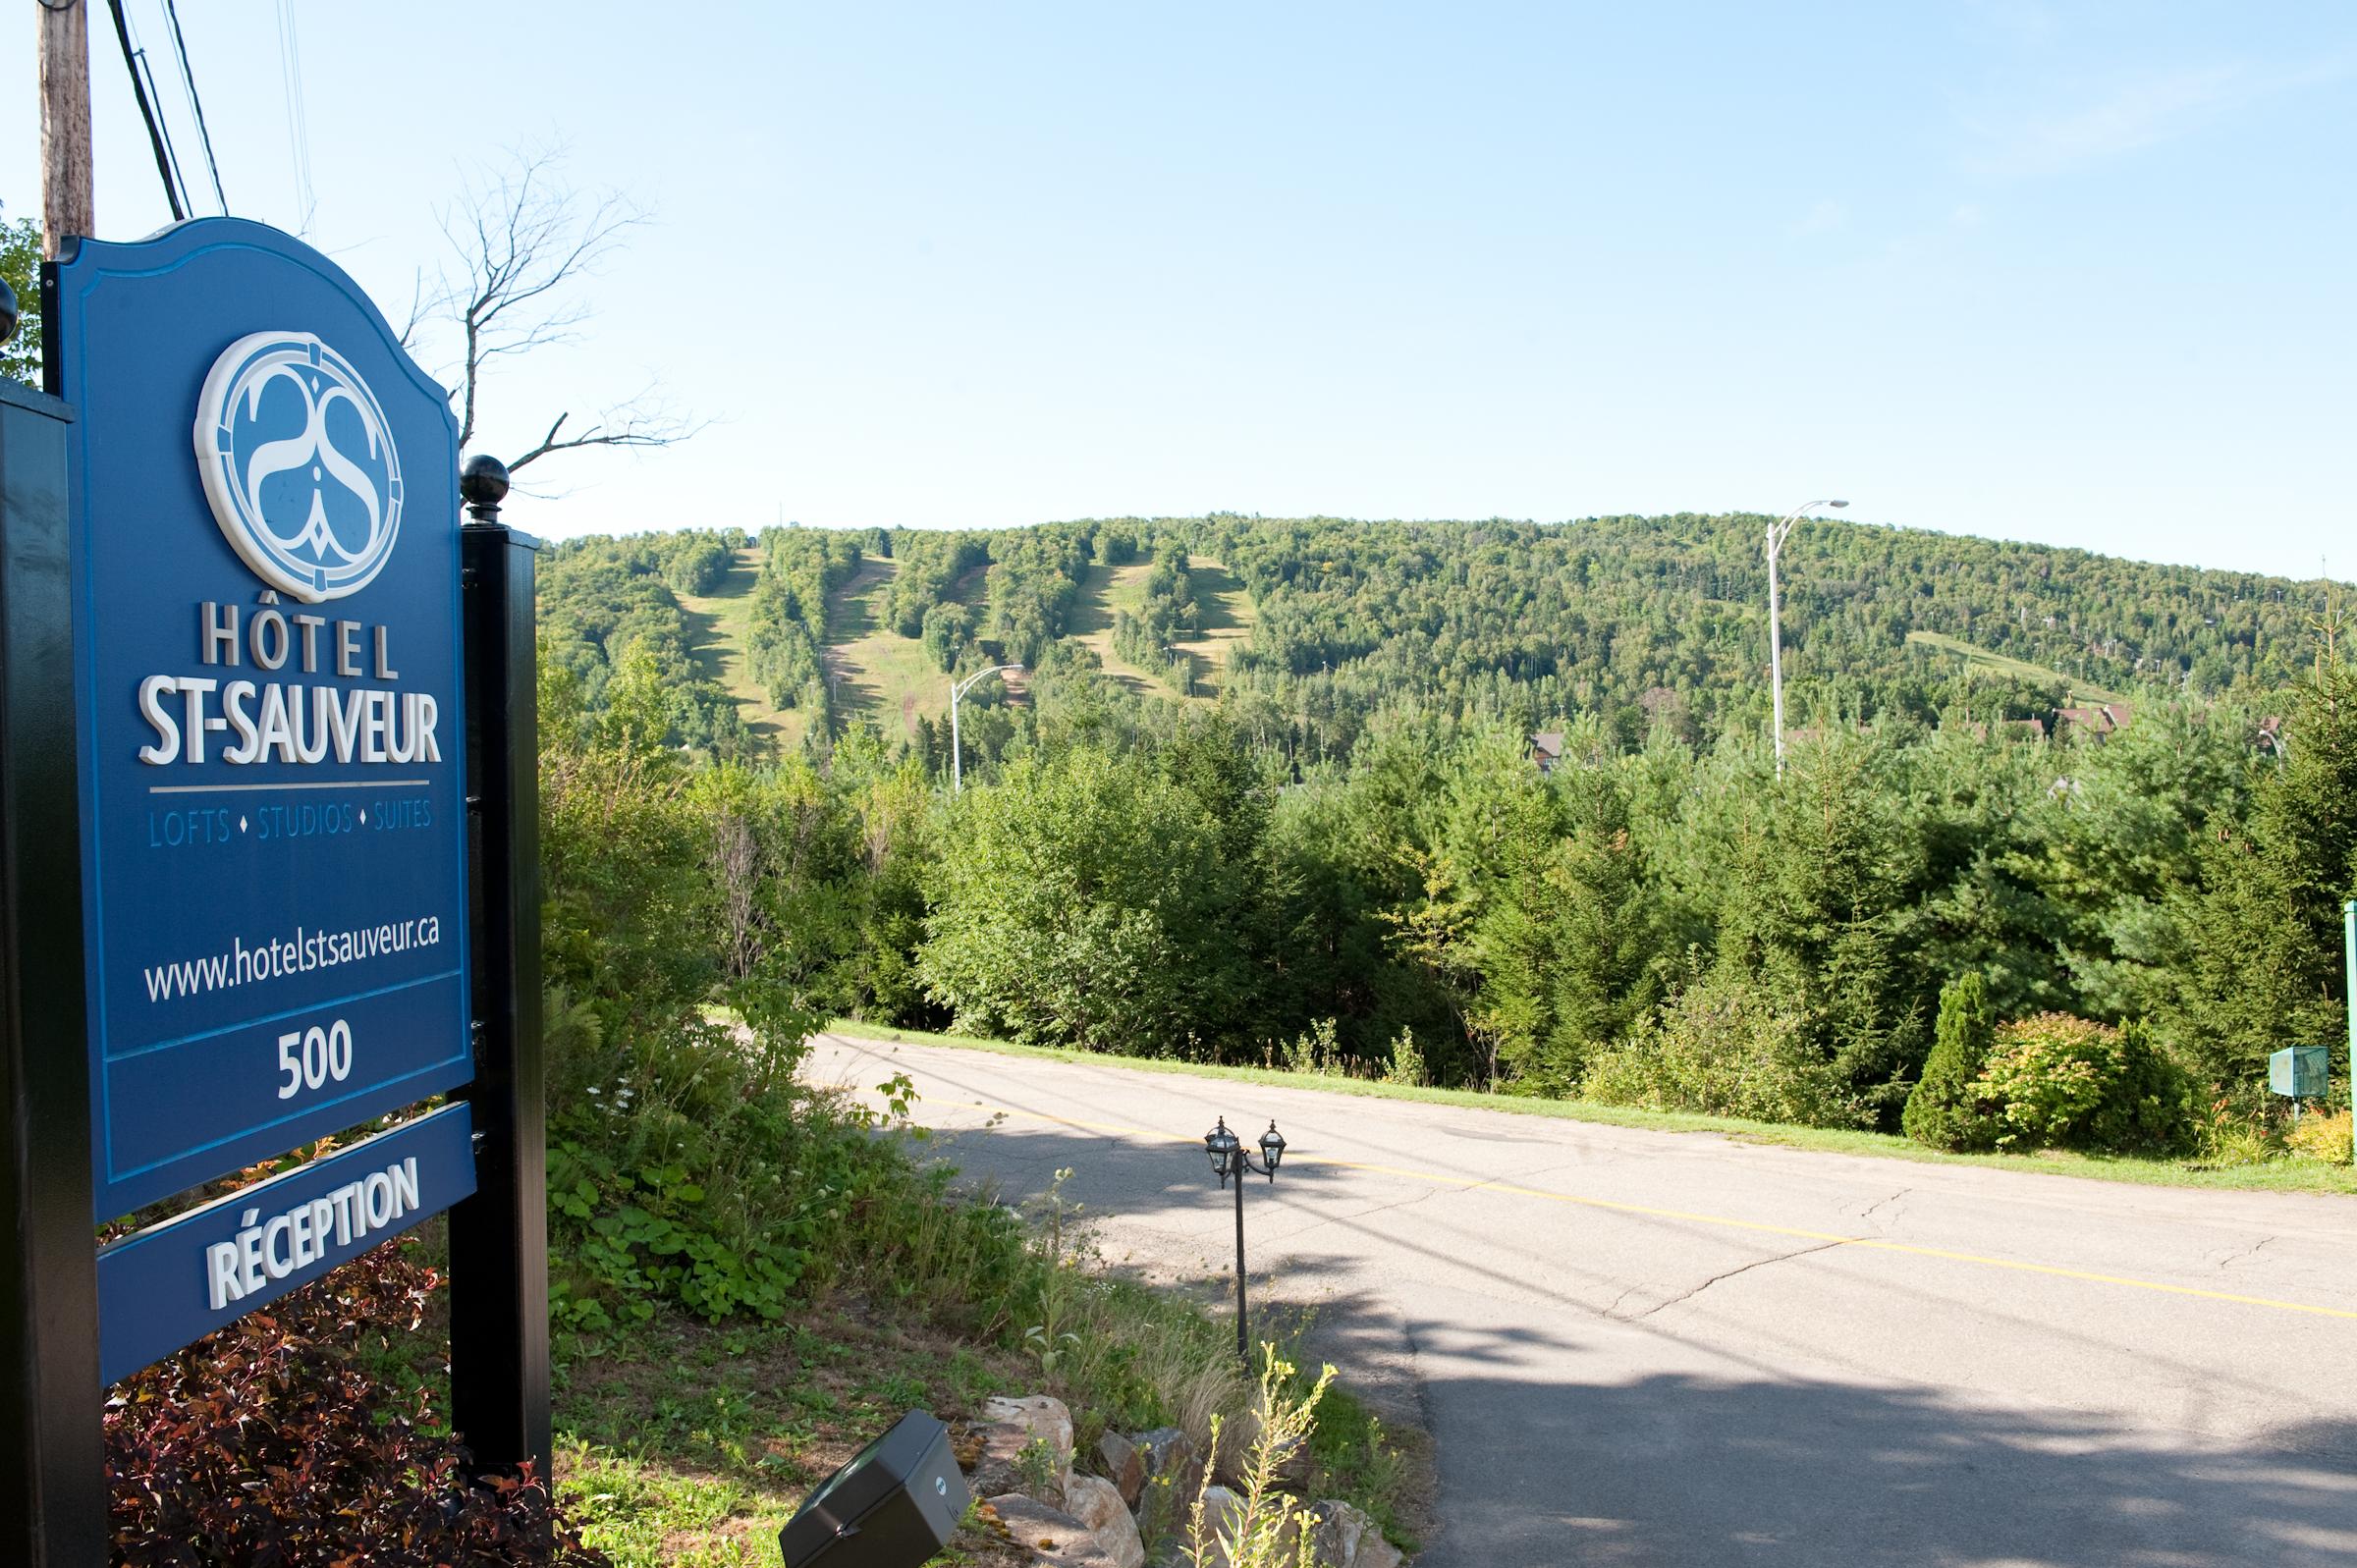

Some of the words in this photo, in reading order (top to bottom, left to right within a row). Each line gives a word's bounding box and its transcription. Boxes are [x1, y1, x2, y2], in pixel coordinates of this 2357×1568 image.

[201, 590, 399, 679] HÔTEL
[138, 675, 442, 765] ST-SAUVEUR
[149, 808, 231, 847] LOFTS
[257, 802, 353, 839] STUDIOS
[374, 799, 432, 832] SUITES
[144, 915, 439, 1002] www.hotelstsauveur.ca
[277, 1019, 353, 1099] 500
[206, 1157, 419, 1310] RÉCEPTION
